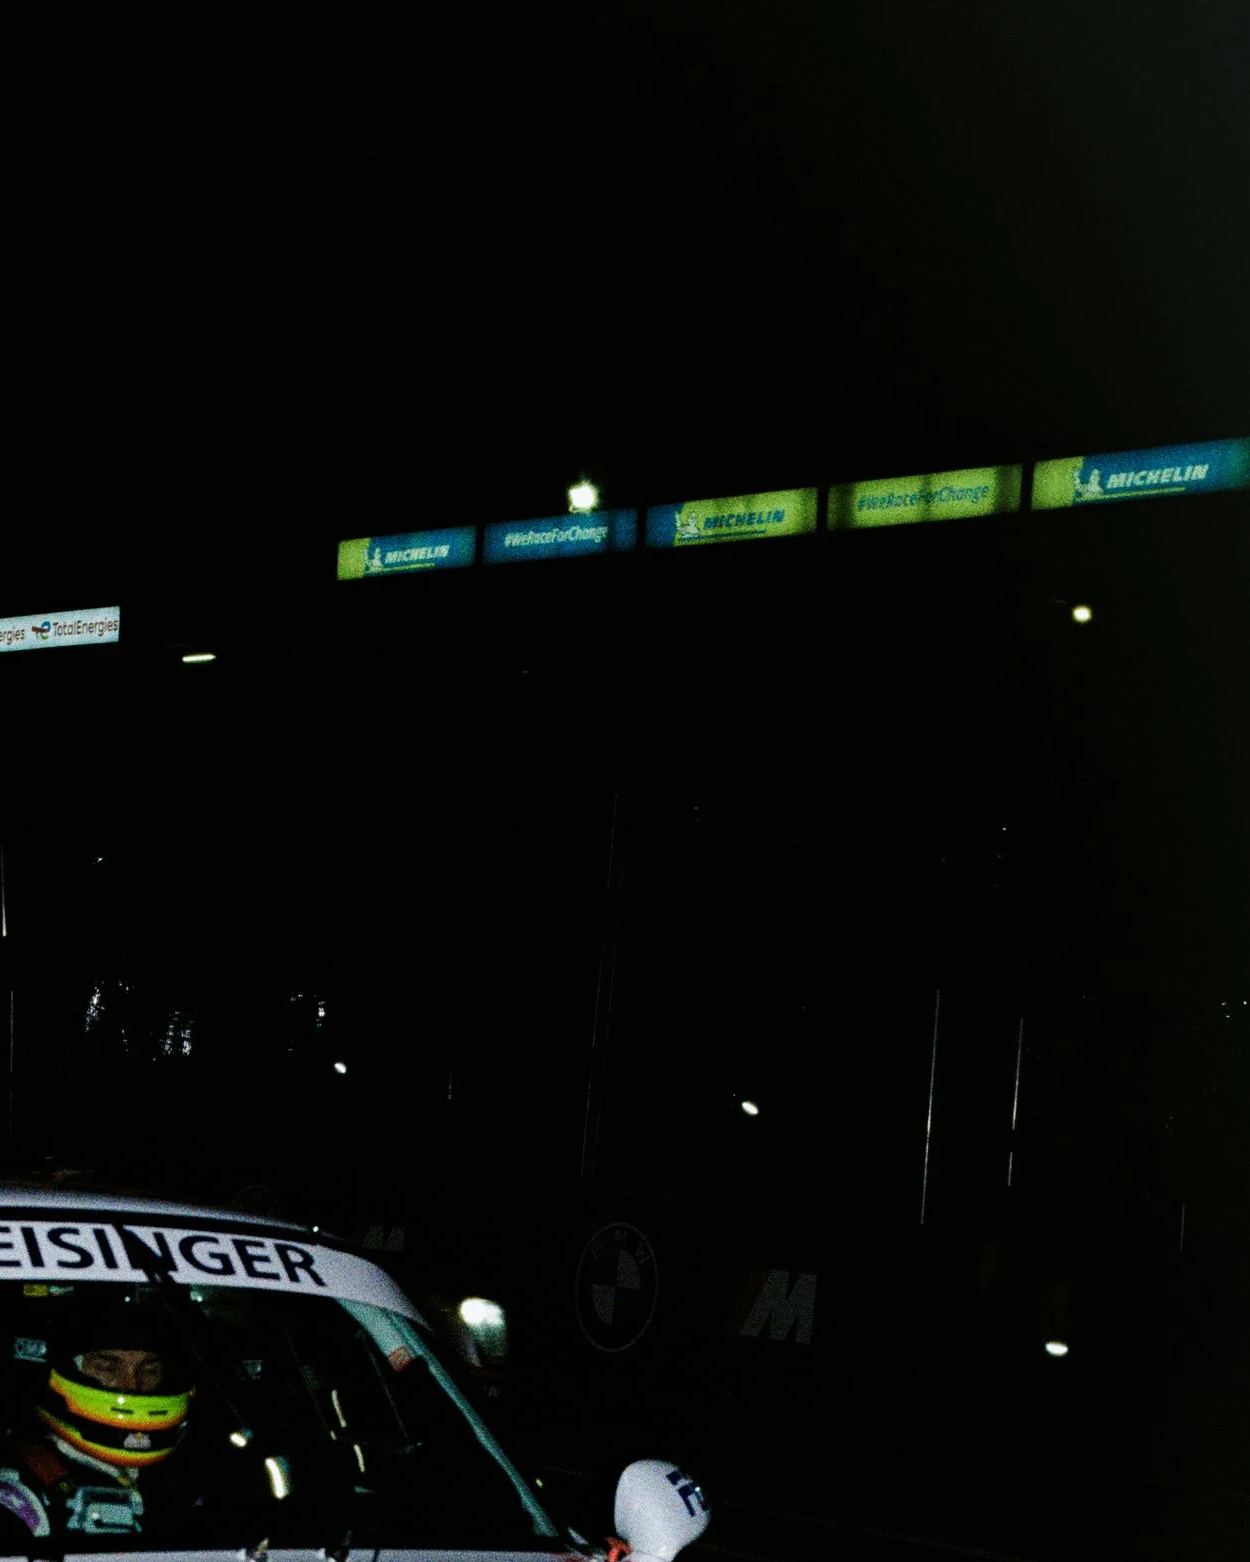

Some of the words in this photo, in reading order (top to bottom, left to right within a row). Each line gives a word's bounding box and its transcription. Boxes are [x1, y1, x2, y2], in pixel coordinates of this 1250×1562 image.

[1106, 463, 1211, 490] MICHELIN
[703, 508, 787, 531] MICHELIN
[504, 525, 609, 548] #WeRaceForChange
[384, 544, 450, 565] MICHELIN
[52, 618, 120, 638] TotalEnergies
